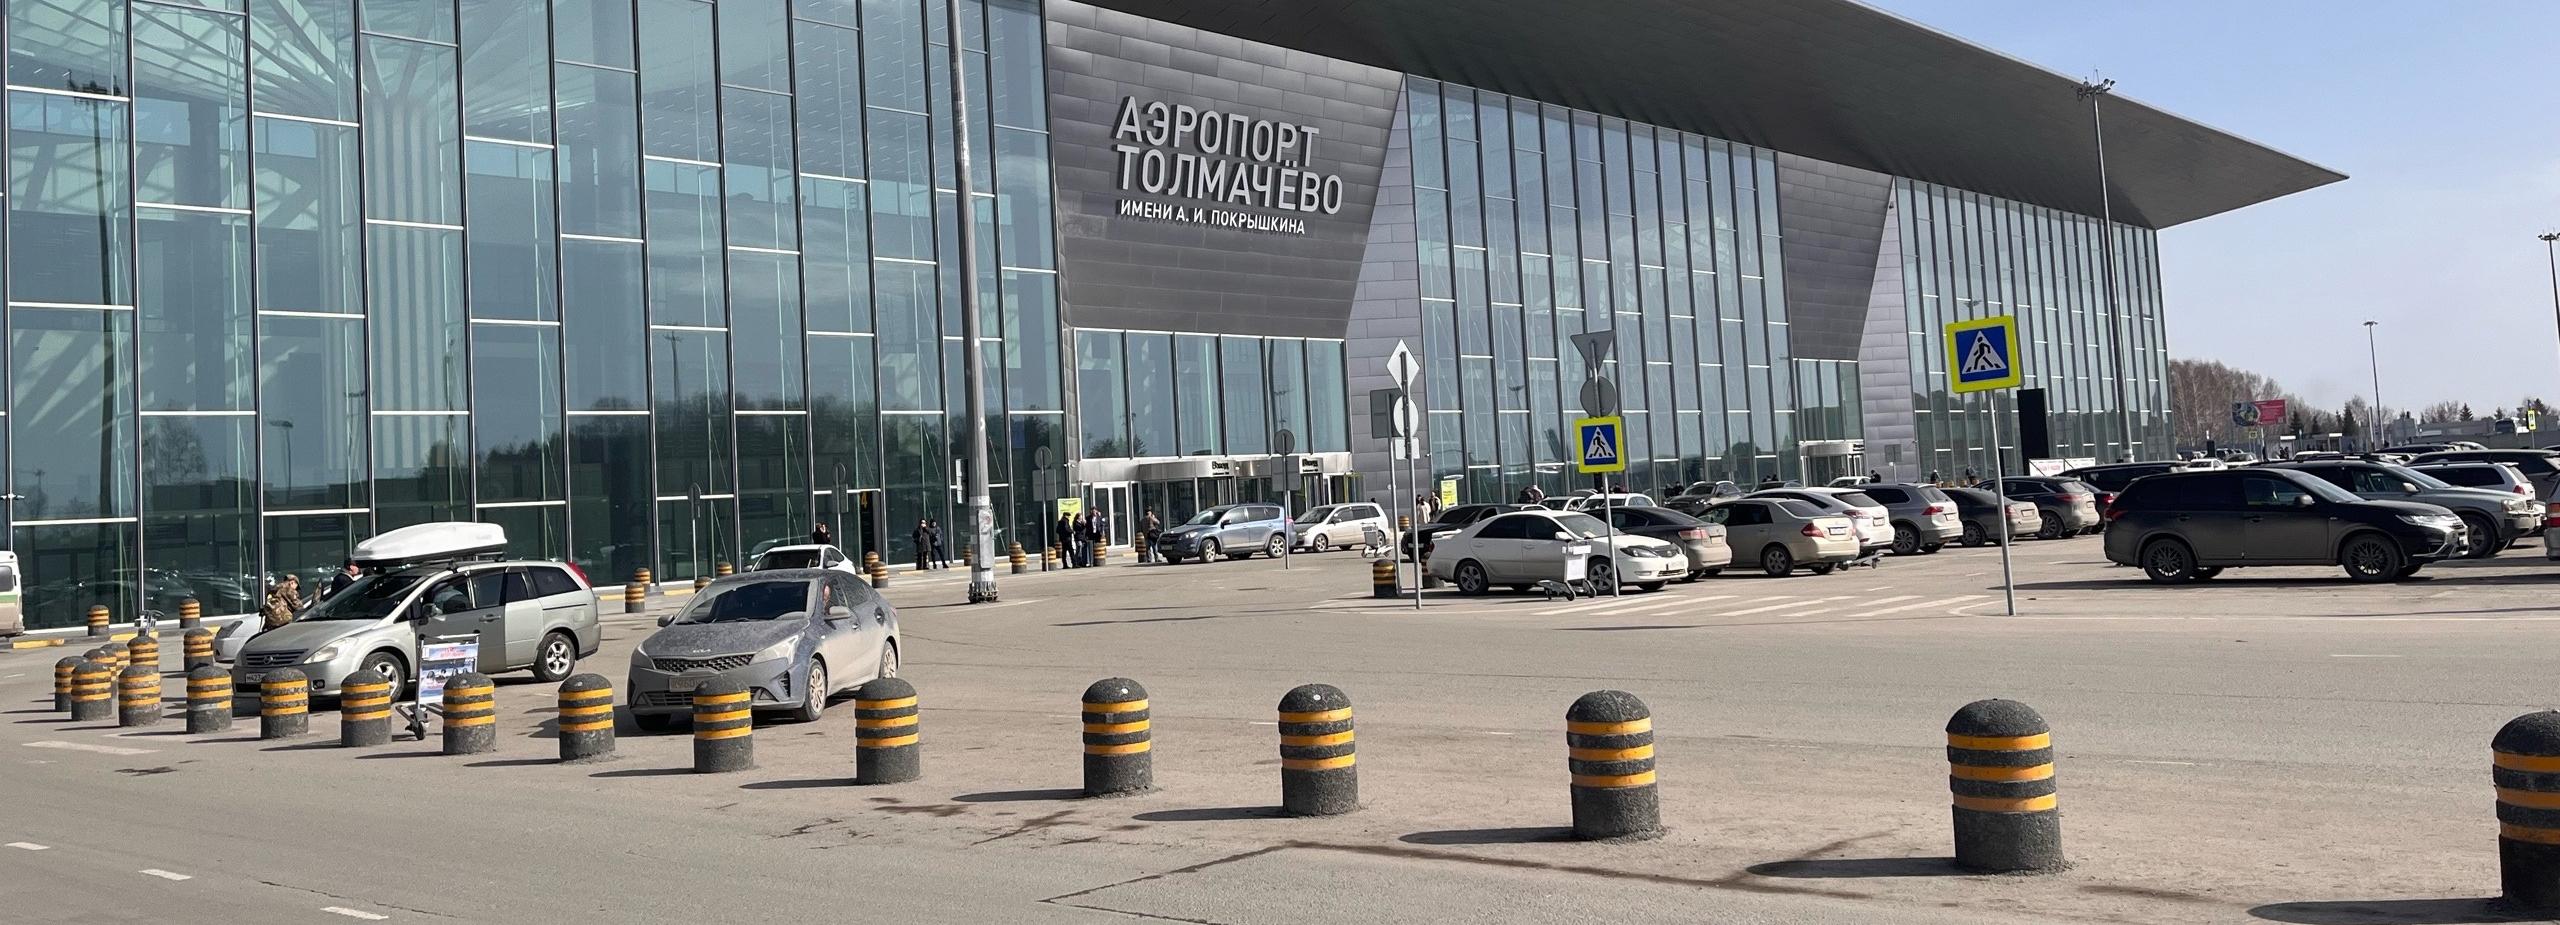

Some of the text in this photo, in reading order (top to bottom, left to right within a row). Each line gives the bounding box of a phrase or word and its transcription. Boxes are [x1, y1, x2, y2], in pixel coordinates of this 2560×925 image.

[1115, 95, 1320, 168] АЭРОПОРТ
[1115, 143, 1343, 215] ТОЛМАЧЁВО
[1120, 198, 1306, 235] ИМЕНИ А. И. ПОКРЫШКИНА
